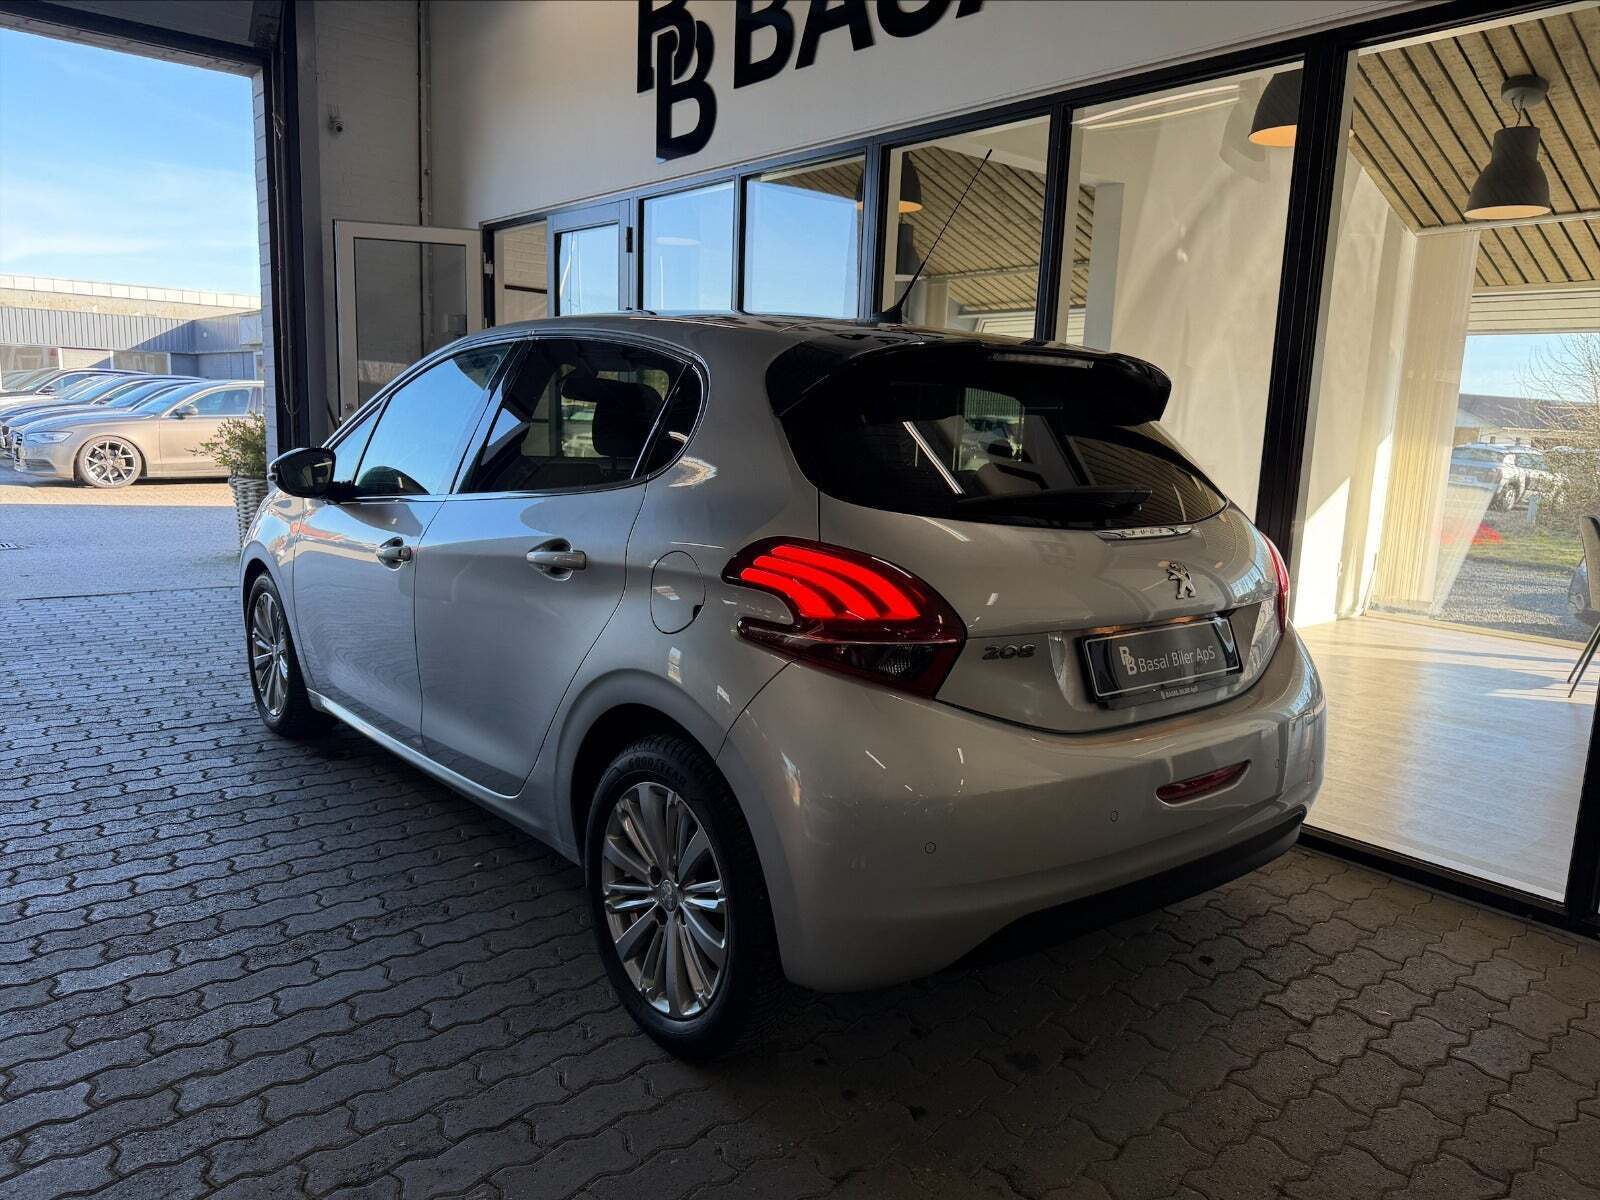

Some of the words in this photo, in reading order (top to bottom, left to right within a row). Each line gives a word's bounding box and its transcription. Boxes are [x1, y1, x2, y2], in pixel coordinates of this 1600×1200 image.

[982, 644, 1035, 660] 208
[1138, 653, 1170, 673] Basal
[1171, 649, 1194, 667] Biler
[1196, 645, 1216, 664] ApS
